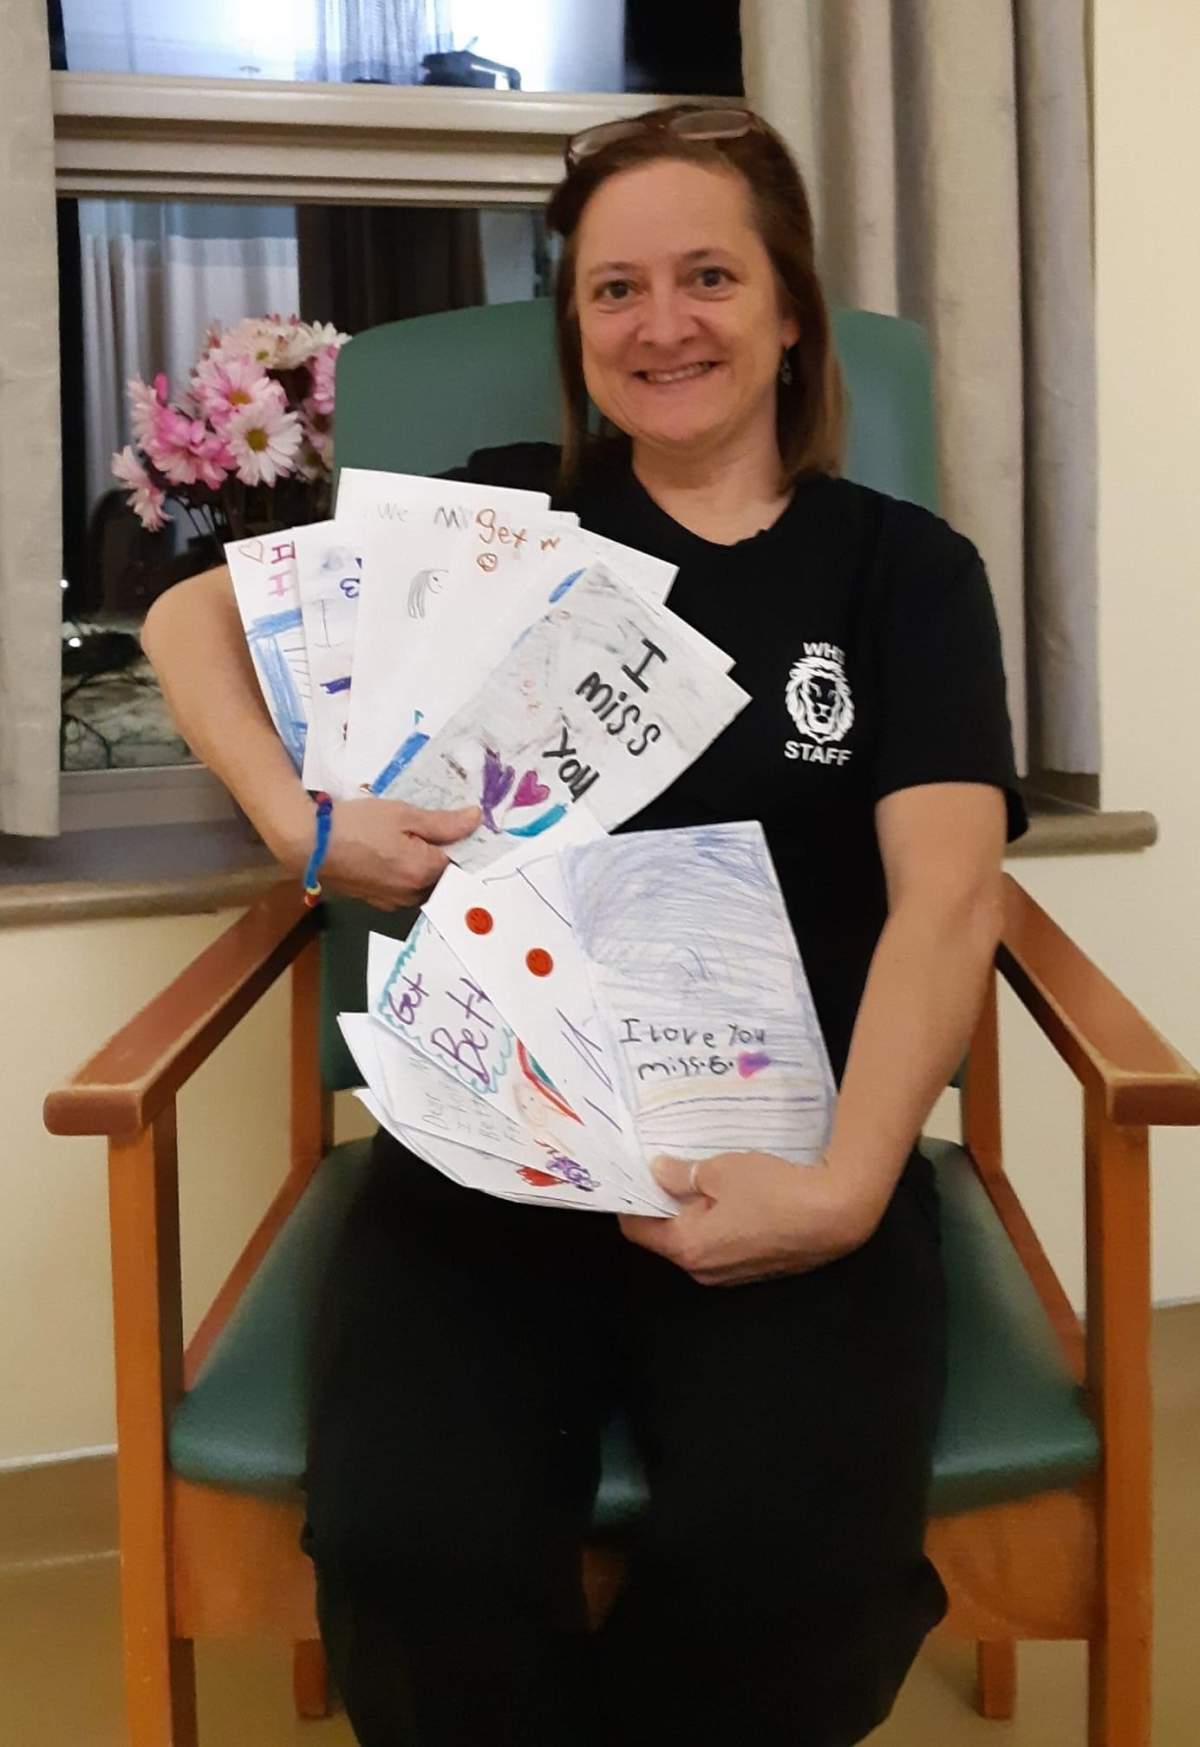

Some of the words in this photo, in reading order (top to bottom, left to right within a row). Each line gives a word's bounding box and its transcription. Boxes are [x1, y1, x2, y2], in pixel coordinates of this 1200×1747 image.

[621, 637, 668, 693] I
[783, 739, 853, 766] STAFF
[619, 1018, 642, 1043] I
